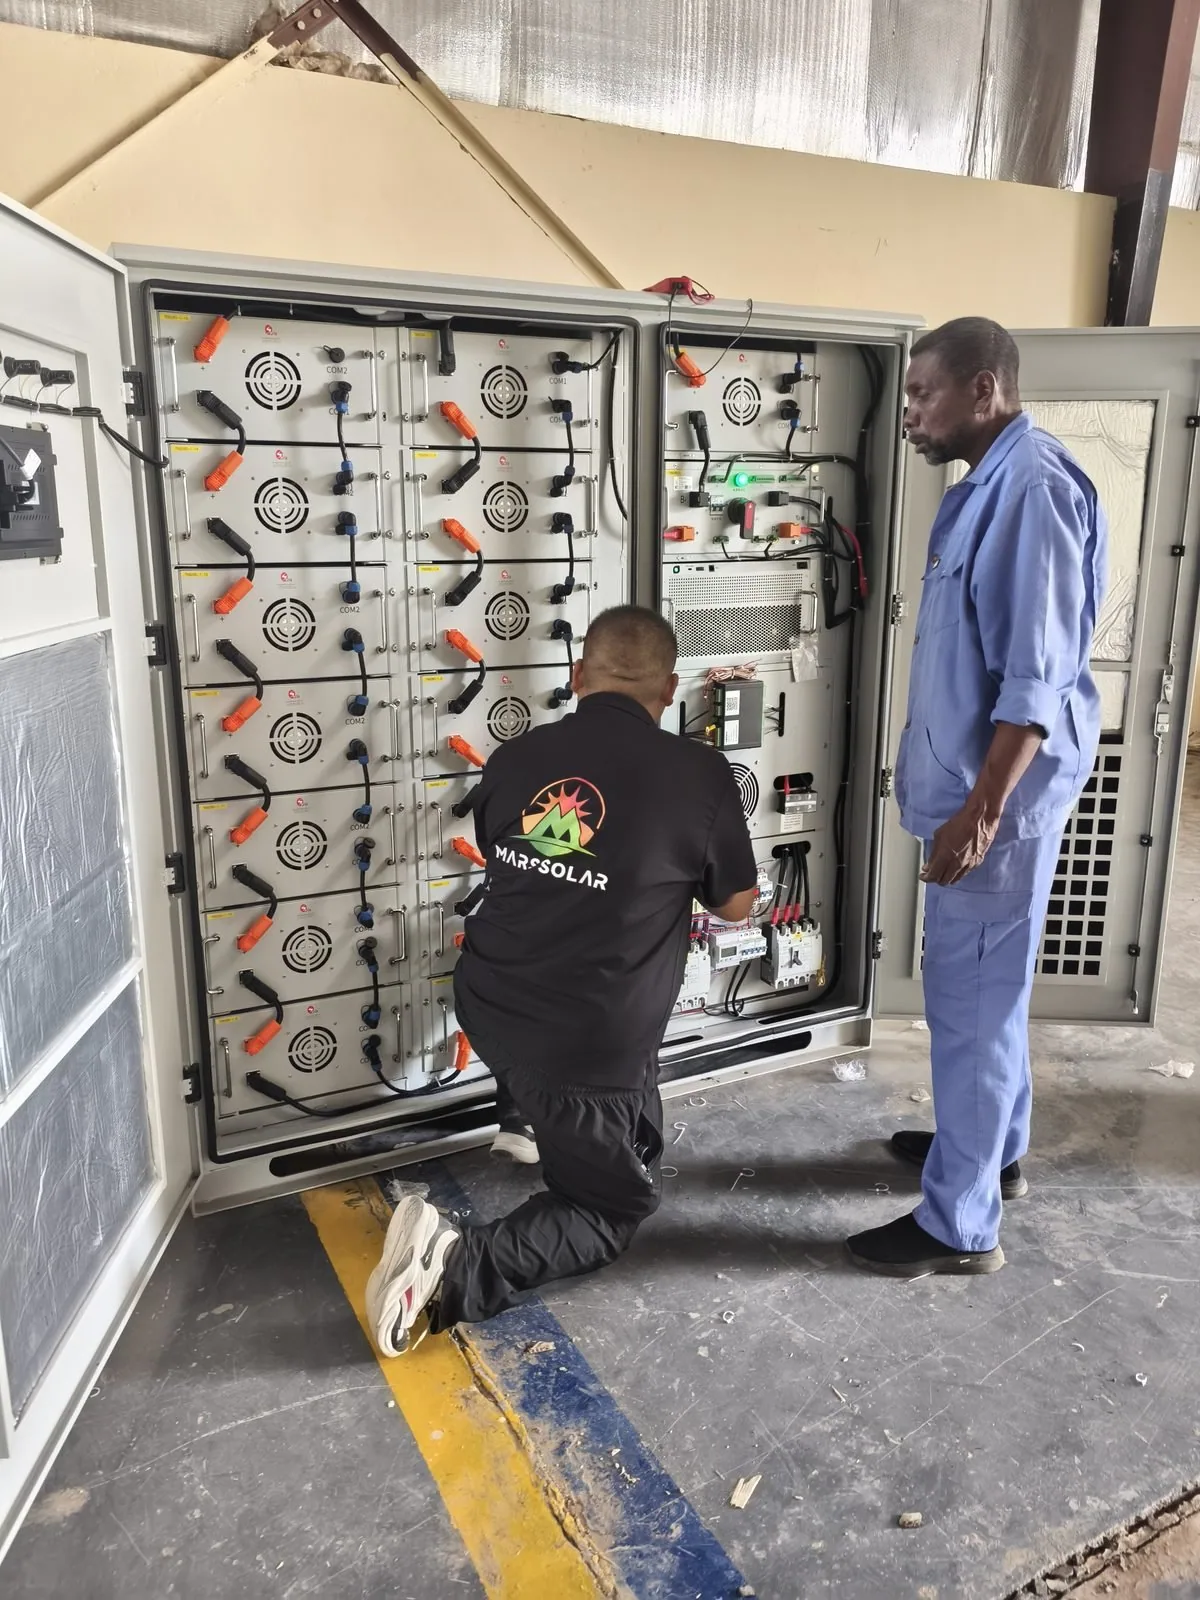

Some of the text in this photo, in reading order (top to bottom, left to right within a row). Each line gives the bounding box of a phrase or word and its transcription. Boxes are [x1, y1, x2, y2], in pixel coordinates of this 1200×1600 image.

[327, 366, 348, 375] COM2
[549, 377, 567, 385] COM1
[340, 606, 360, 615] COM2
[345, 717, 366, 726] COM2
[350, 823, 370, 832] COM2
[495, 844, 609, 891] MARSSOLAR
